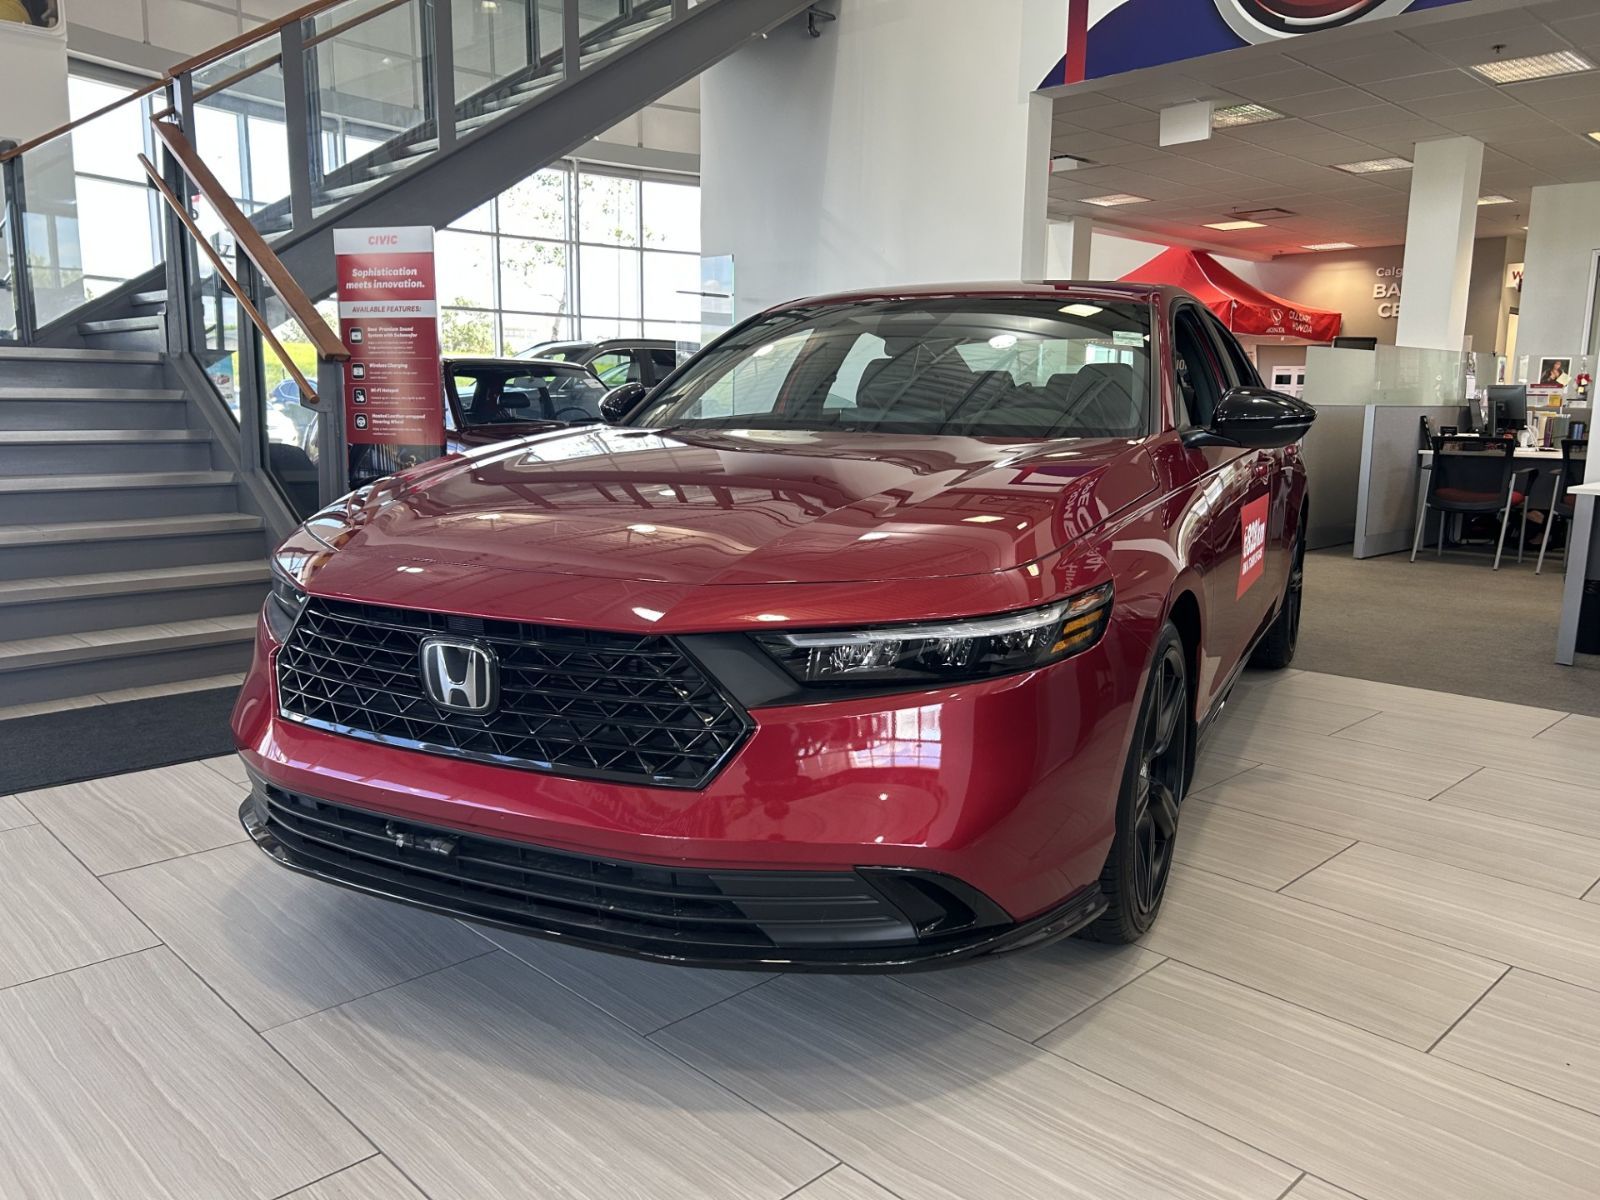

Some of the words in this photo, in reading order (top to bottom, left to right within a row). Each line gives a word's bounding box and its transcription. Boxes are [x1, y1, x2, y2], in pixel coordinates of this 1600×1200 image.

[368, 235, 398, 245] CIVIC
[352, 266, 417, 278] Sophistication
[346, 281, 372, 290] meets
[373, 279, 425, 290] innovation.
[1373, 283, 1401, 298] BA
[352, 305, 386, 313] AVAILABLE
[387, 305, 422, 313] FEATURES:
